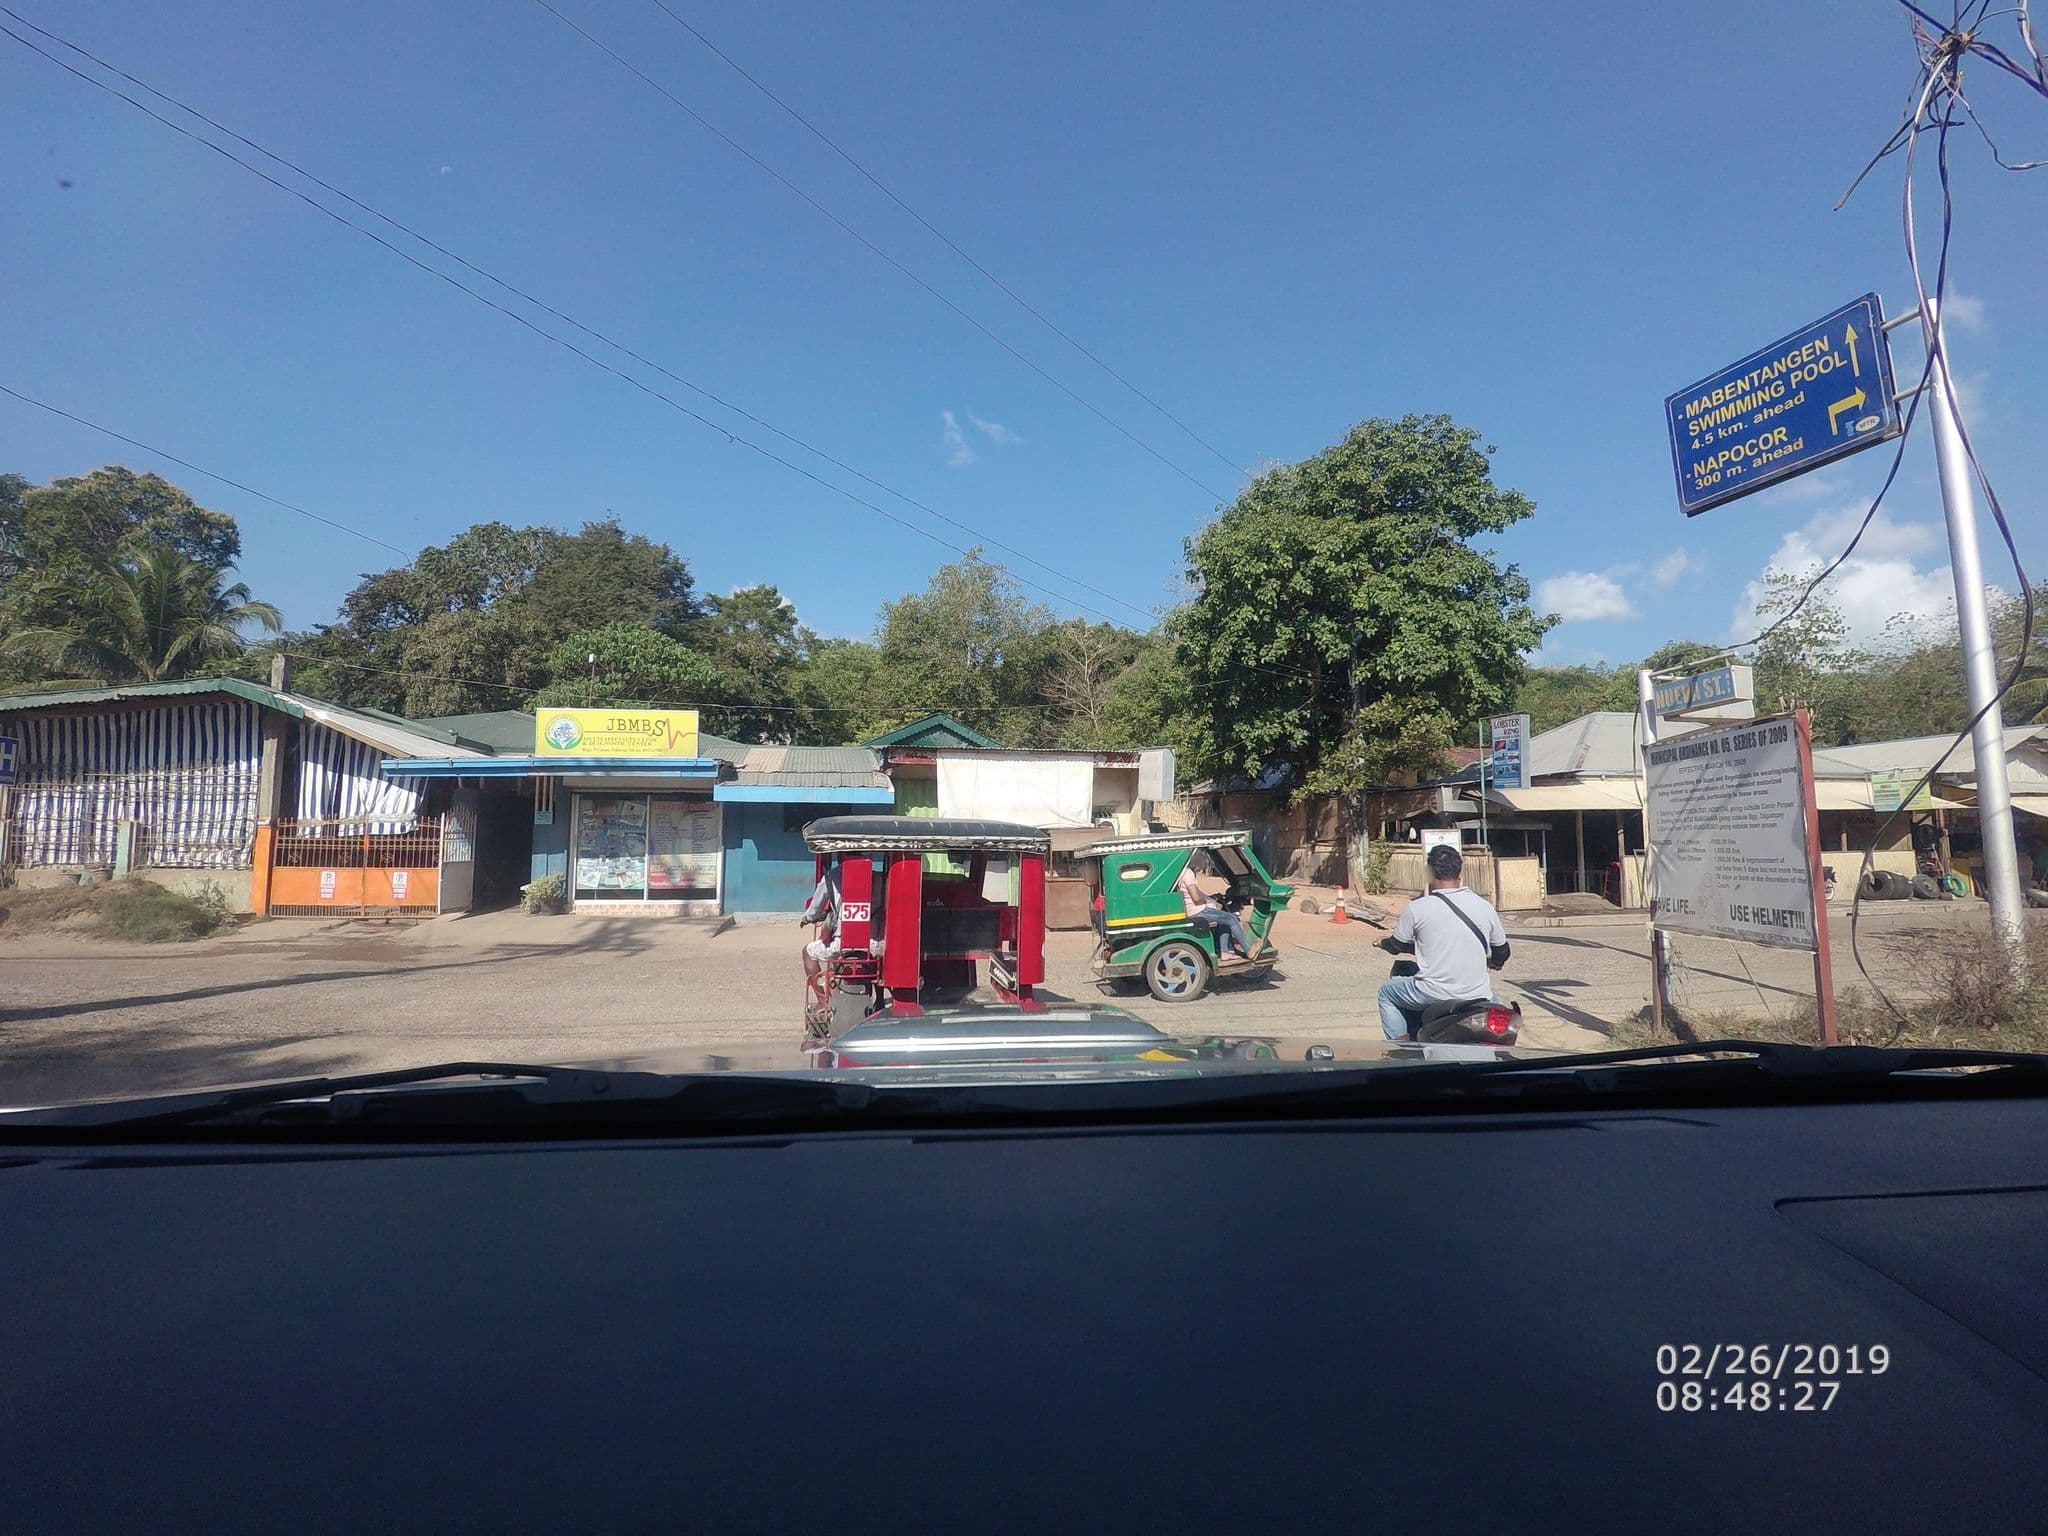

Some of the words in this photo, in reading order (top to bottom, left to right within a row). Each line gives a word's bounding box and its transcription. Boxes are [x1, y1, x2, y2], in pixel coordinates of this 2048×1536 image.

[1685, 335, 1830, 419] MABENTANGEN
[1688, 379, 1786, 436] SWIMMING
[1790, 351, 1848, 389] POOL
[1691, 432, 1714, 450] 4.5
[1718, 421, 1749, 440] km.
[1753, 392, 1805, 424] ahead
[1693, 426, 1789, 478] NAPOCOR
[1695, 473, 1722, 490] 300
[1726, 462, 1748, 477] m.
[1752, 437, 1804, 469] ahead
[1655, 681, 1701, 709] NUEVA
[1703, 676, 1726, 698] ST.
[1494, 718, 1520, 729] LOBSTER
[1733, 731, 1757, 751] SERIES
[1758, 730, 1768, 747] OF
[1768, 724, 1788, 746] 2009
[843, 904, 869, 920] 575
[1656, 896, 1671, 913] AVE
[1729, 904, 1750, 923] USE
[1752, 906, 1806, 930] HELMET!!!
